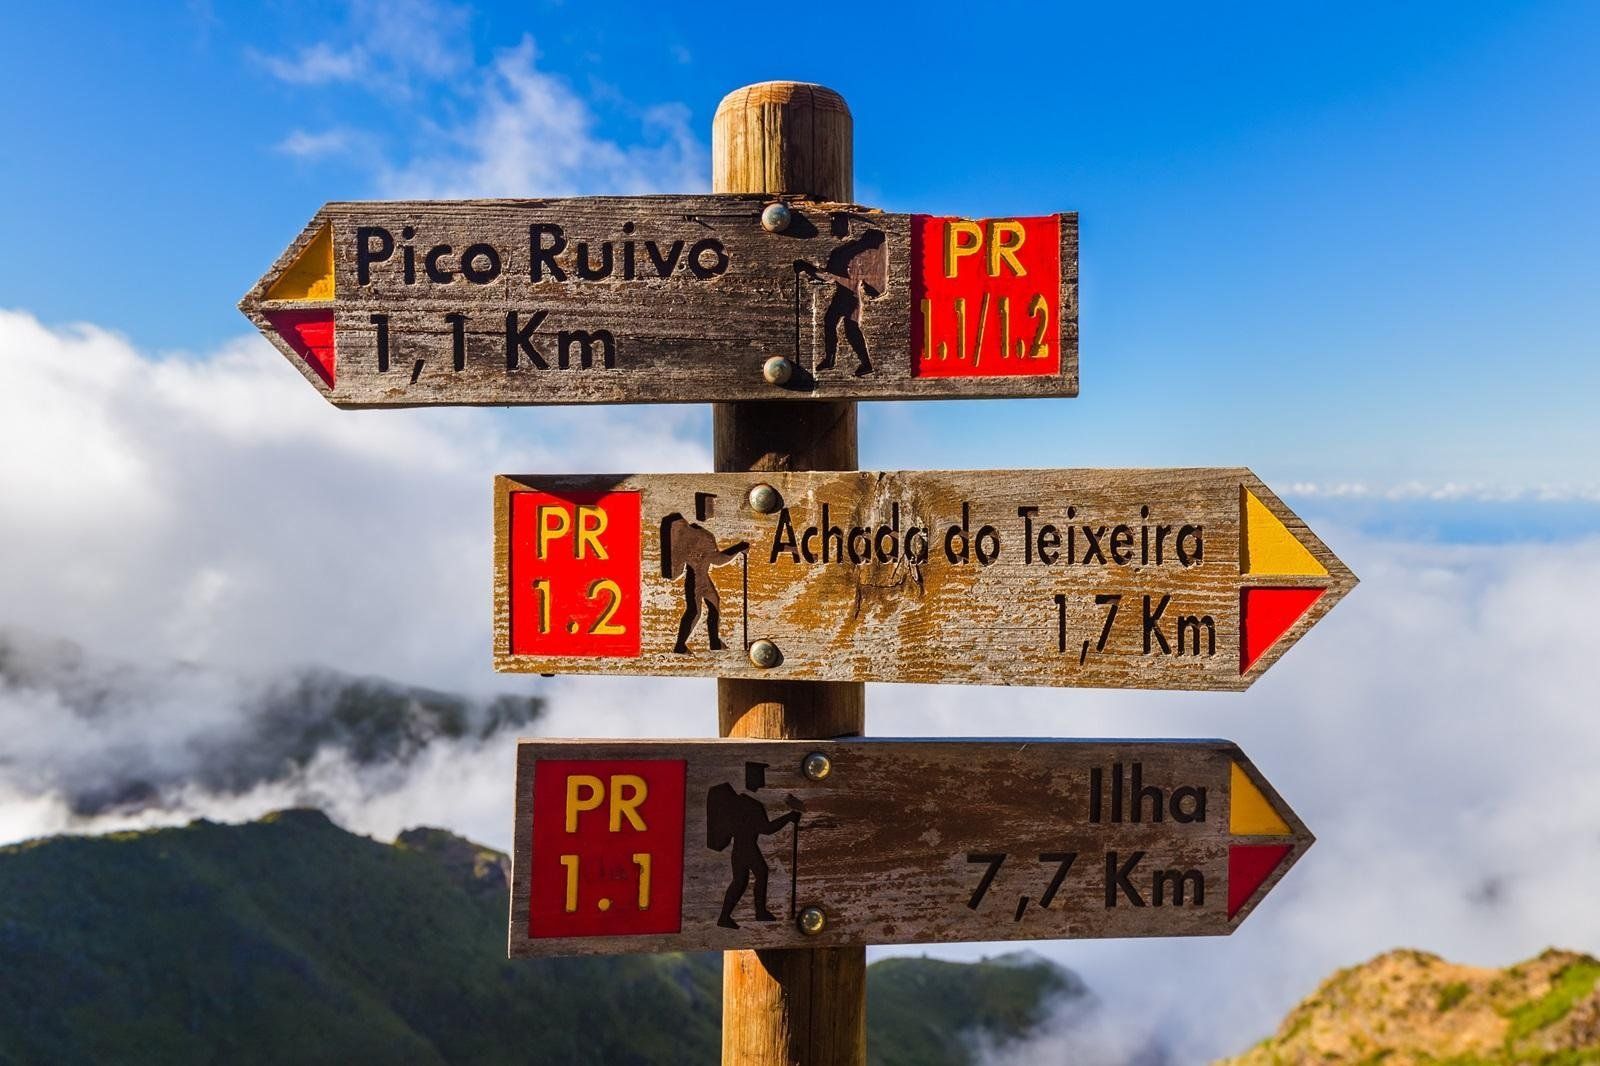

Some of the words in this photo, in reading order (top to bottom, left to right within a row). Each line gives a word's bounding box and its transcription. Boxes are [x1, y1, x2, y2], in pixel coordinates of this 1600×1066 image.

[356, 226, 500, 287] Pico
[529, 222, 730, 284] Ruivo
[944, 221, 1028, 279] PR
[370, 313, 472, 385] 1,1
[505, 311, 617, 372] Km
[536, 504, 609, 561] PR
[770, 502, 928, 567] Achada
[944, 501, 1000, 568] do
[1018, 505, 1204, 569] Teixeira
[532, 578, 627, 636] 1.2
[1054, 593, 1121, 666] 1,7
[1142, 593, 1216, 657] Km
[565, 775, 648, 833] PR
[1089, 761, 1207, 824] Ilha
[560, 852, 651, 913] 1.1
[966, 852, 1078, 923] 7,7
[1104, 850, 1206, 909] Km
